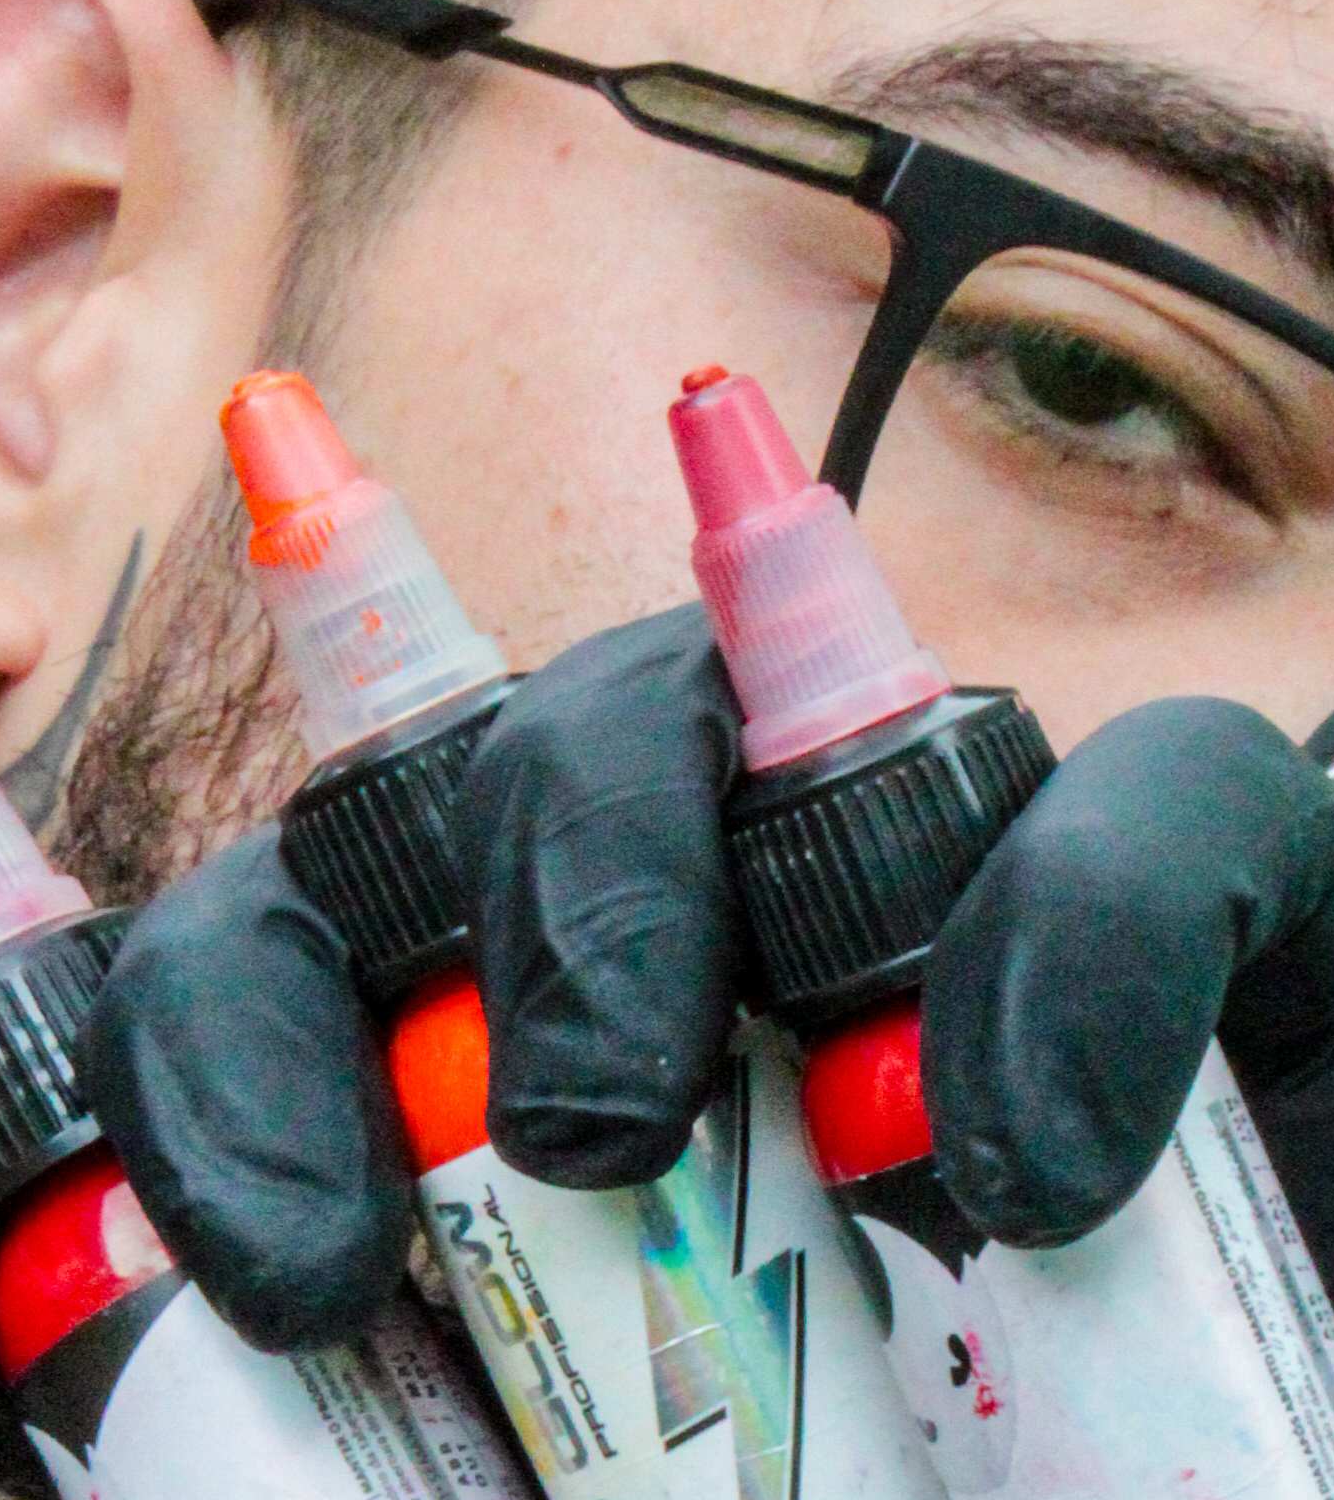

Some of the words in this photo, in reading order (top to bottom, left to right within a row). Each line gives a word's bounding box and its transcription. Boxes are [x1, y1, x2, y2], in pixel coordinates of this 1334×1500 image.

[1192, 1189, 1233, 1264] PRODUTO
[434, 1200, 588, 1472] GLOW
[472, 1181, 619, 1460] PROFISSIONAL
[1230, 1279, 1267, 1344] MANTER
[333, 1434, 374, 1495] MANTER
[437, 1440, 471, 1489] ABR
[455, 1440, 489, 1489] OUT
[1284, 1415, 1314, 1458] APÓS
[1306, 1458, 1331, 1495] DIAS
